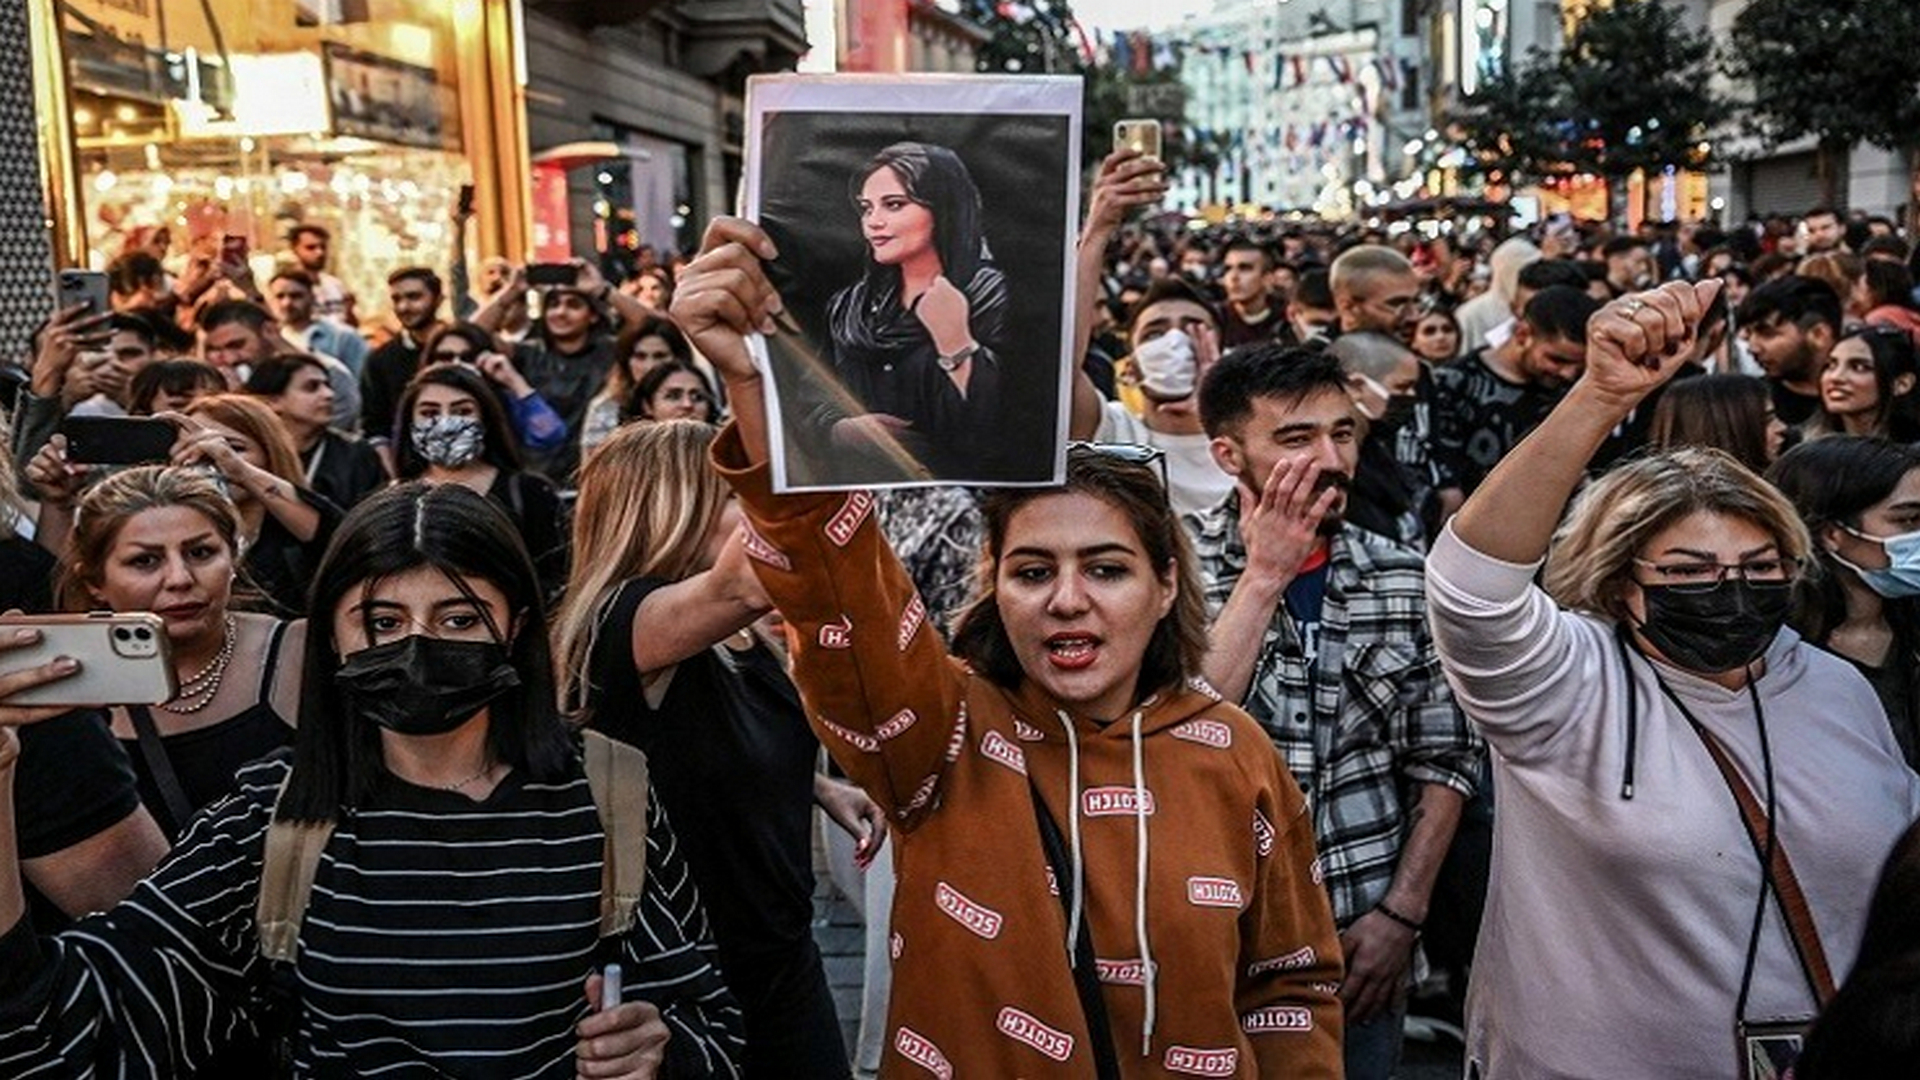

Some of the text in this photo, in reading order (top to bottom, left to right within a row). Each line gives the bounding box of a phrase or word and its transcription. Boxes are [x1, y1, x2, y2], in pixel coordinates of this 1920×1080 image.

[834, 491, 869, 538] OTCH
[941, 890, 997, 931] SCOTCH
[1003, 1014, 1069, 1054] SCOTCH
[1248, 1013, 1306, 1027] SCOTCH
[1171, 1053, 1235, 1073] SCOTCH
